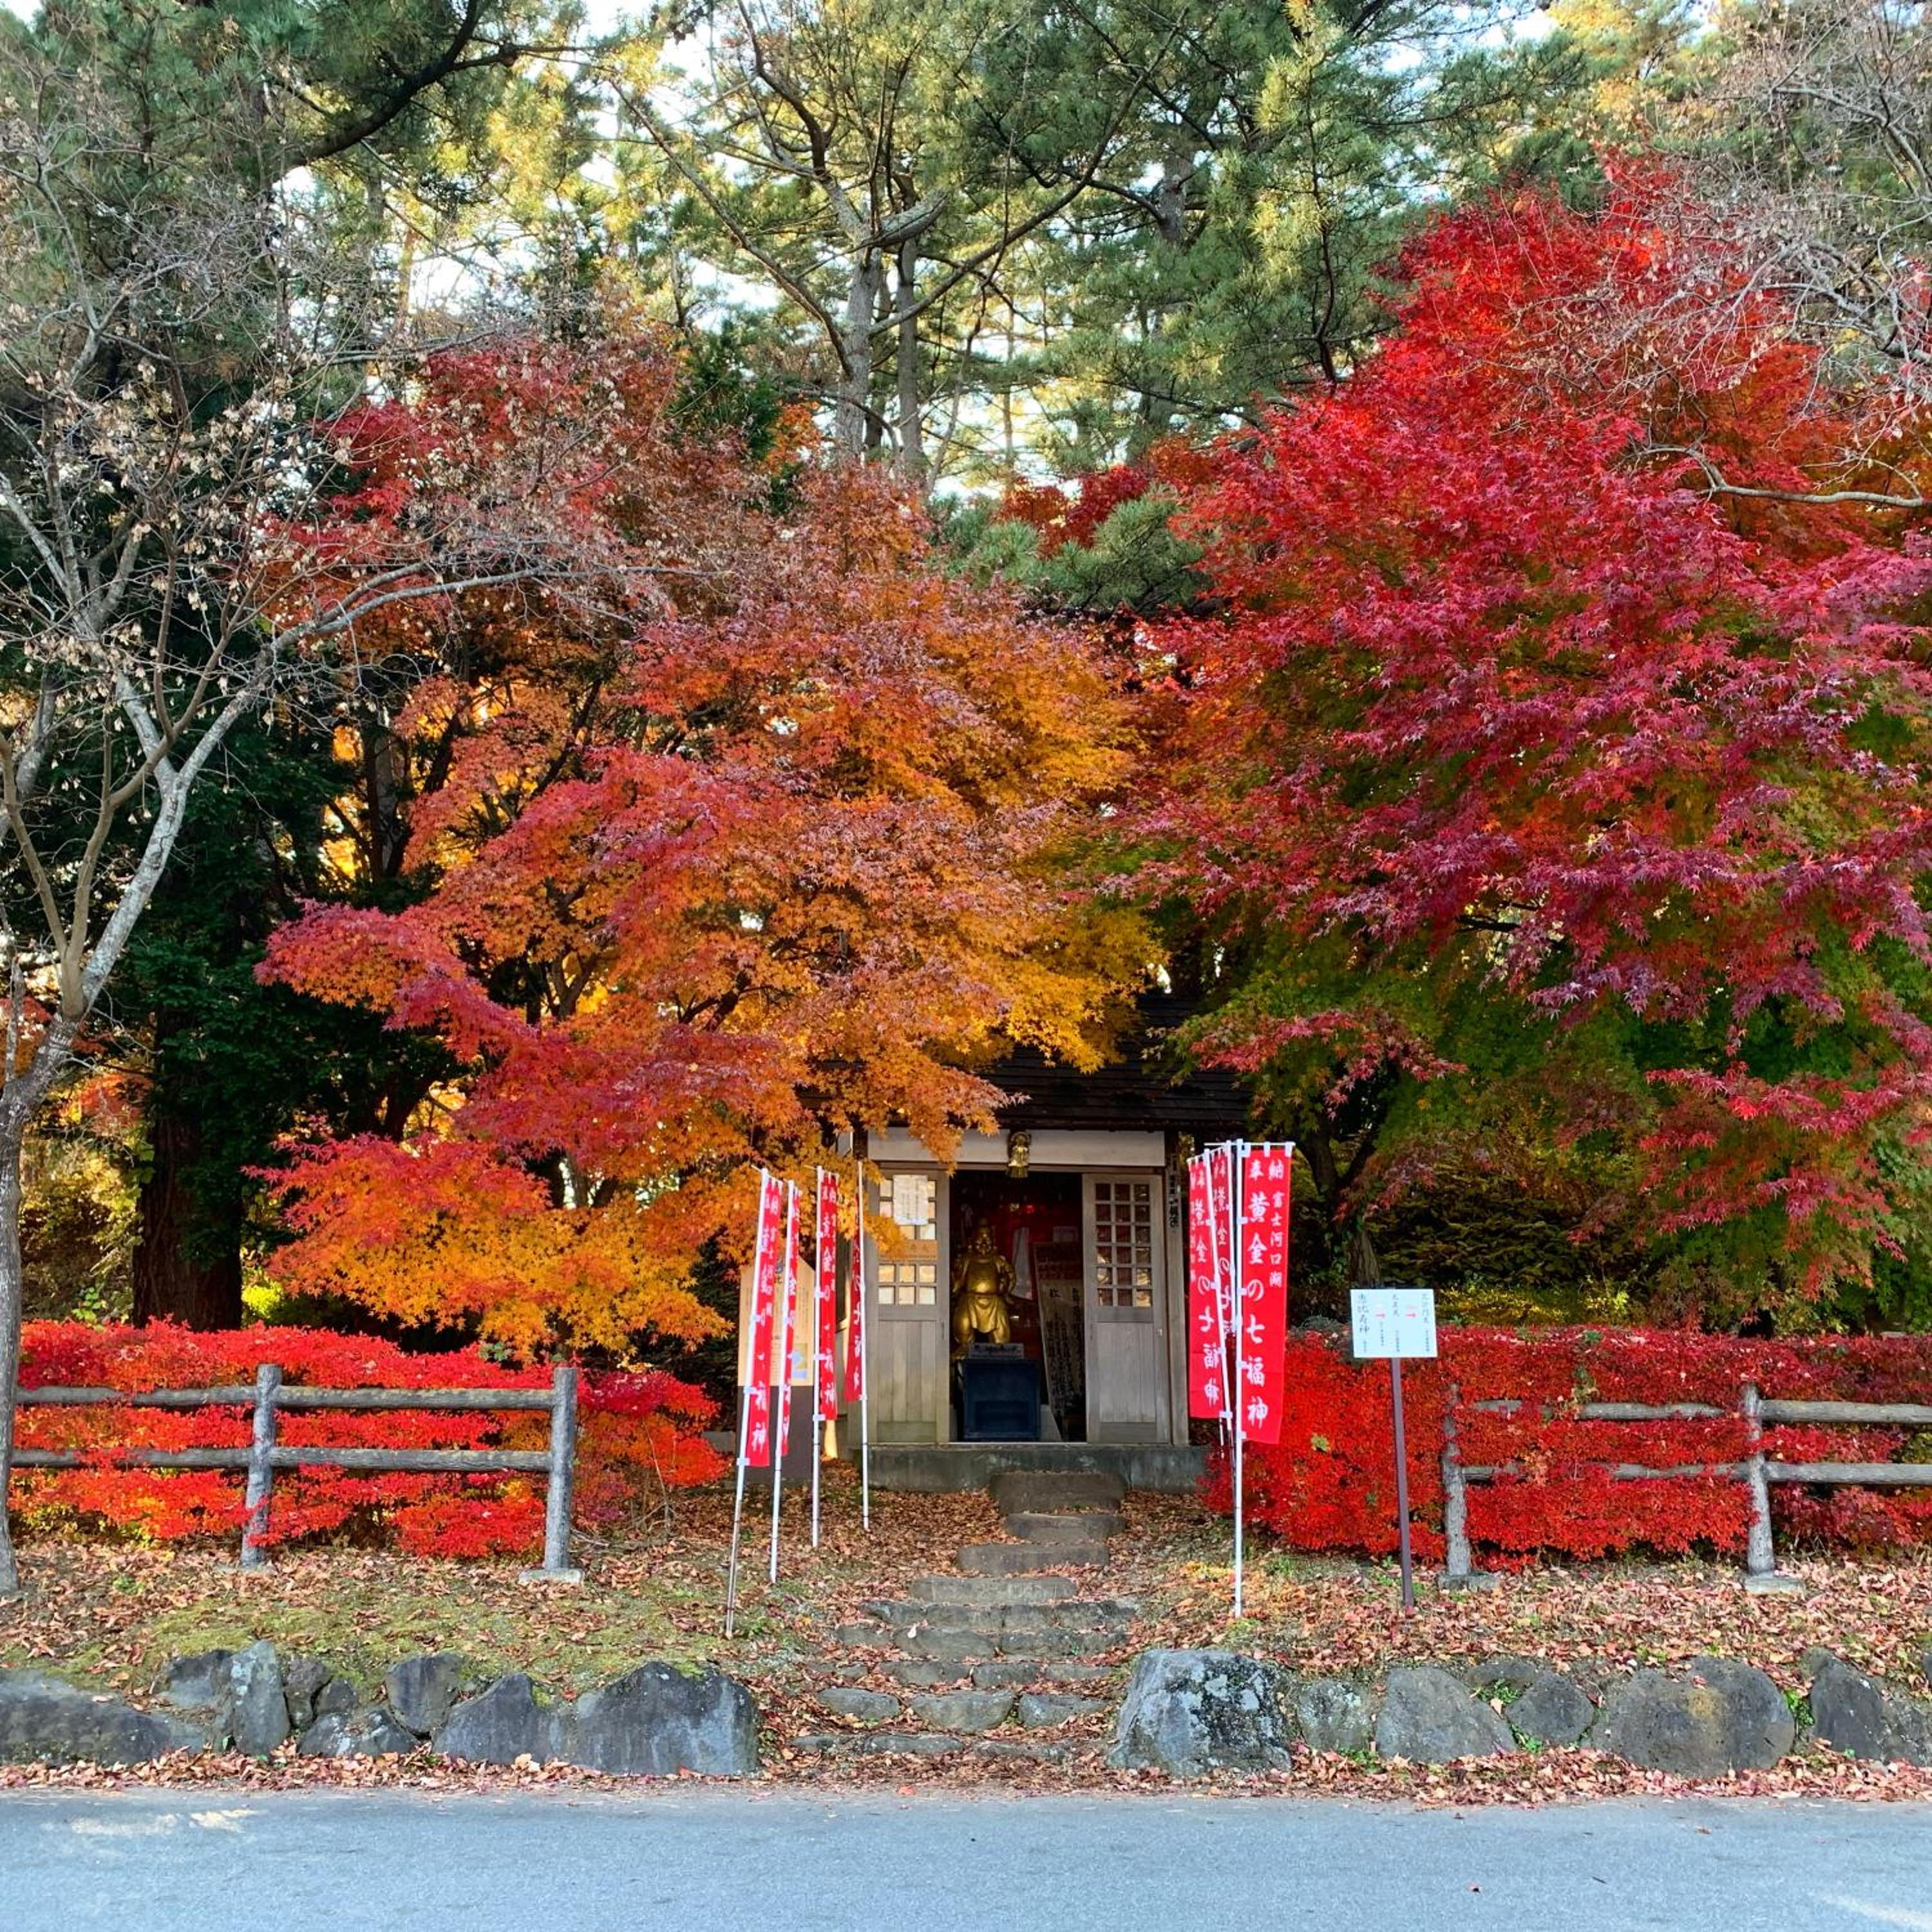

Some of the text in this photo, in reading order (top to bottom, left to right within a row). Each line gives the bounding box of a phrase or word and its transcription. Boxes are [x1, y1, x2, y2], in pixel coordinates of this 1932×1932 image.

[1249, 1159, 1285, 1180] 奉納
[1269, 1191, 1285, 1287] 富士河口湖
[752, 1223, 770, 1453] 黄金の福神
[822, 1212, 835, 1408] 黄金の福神
[1247, 1191, 1271, 1430] 黄金の七福神
[1357, 1293, 1370, 1335] 恵比寿神
